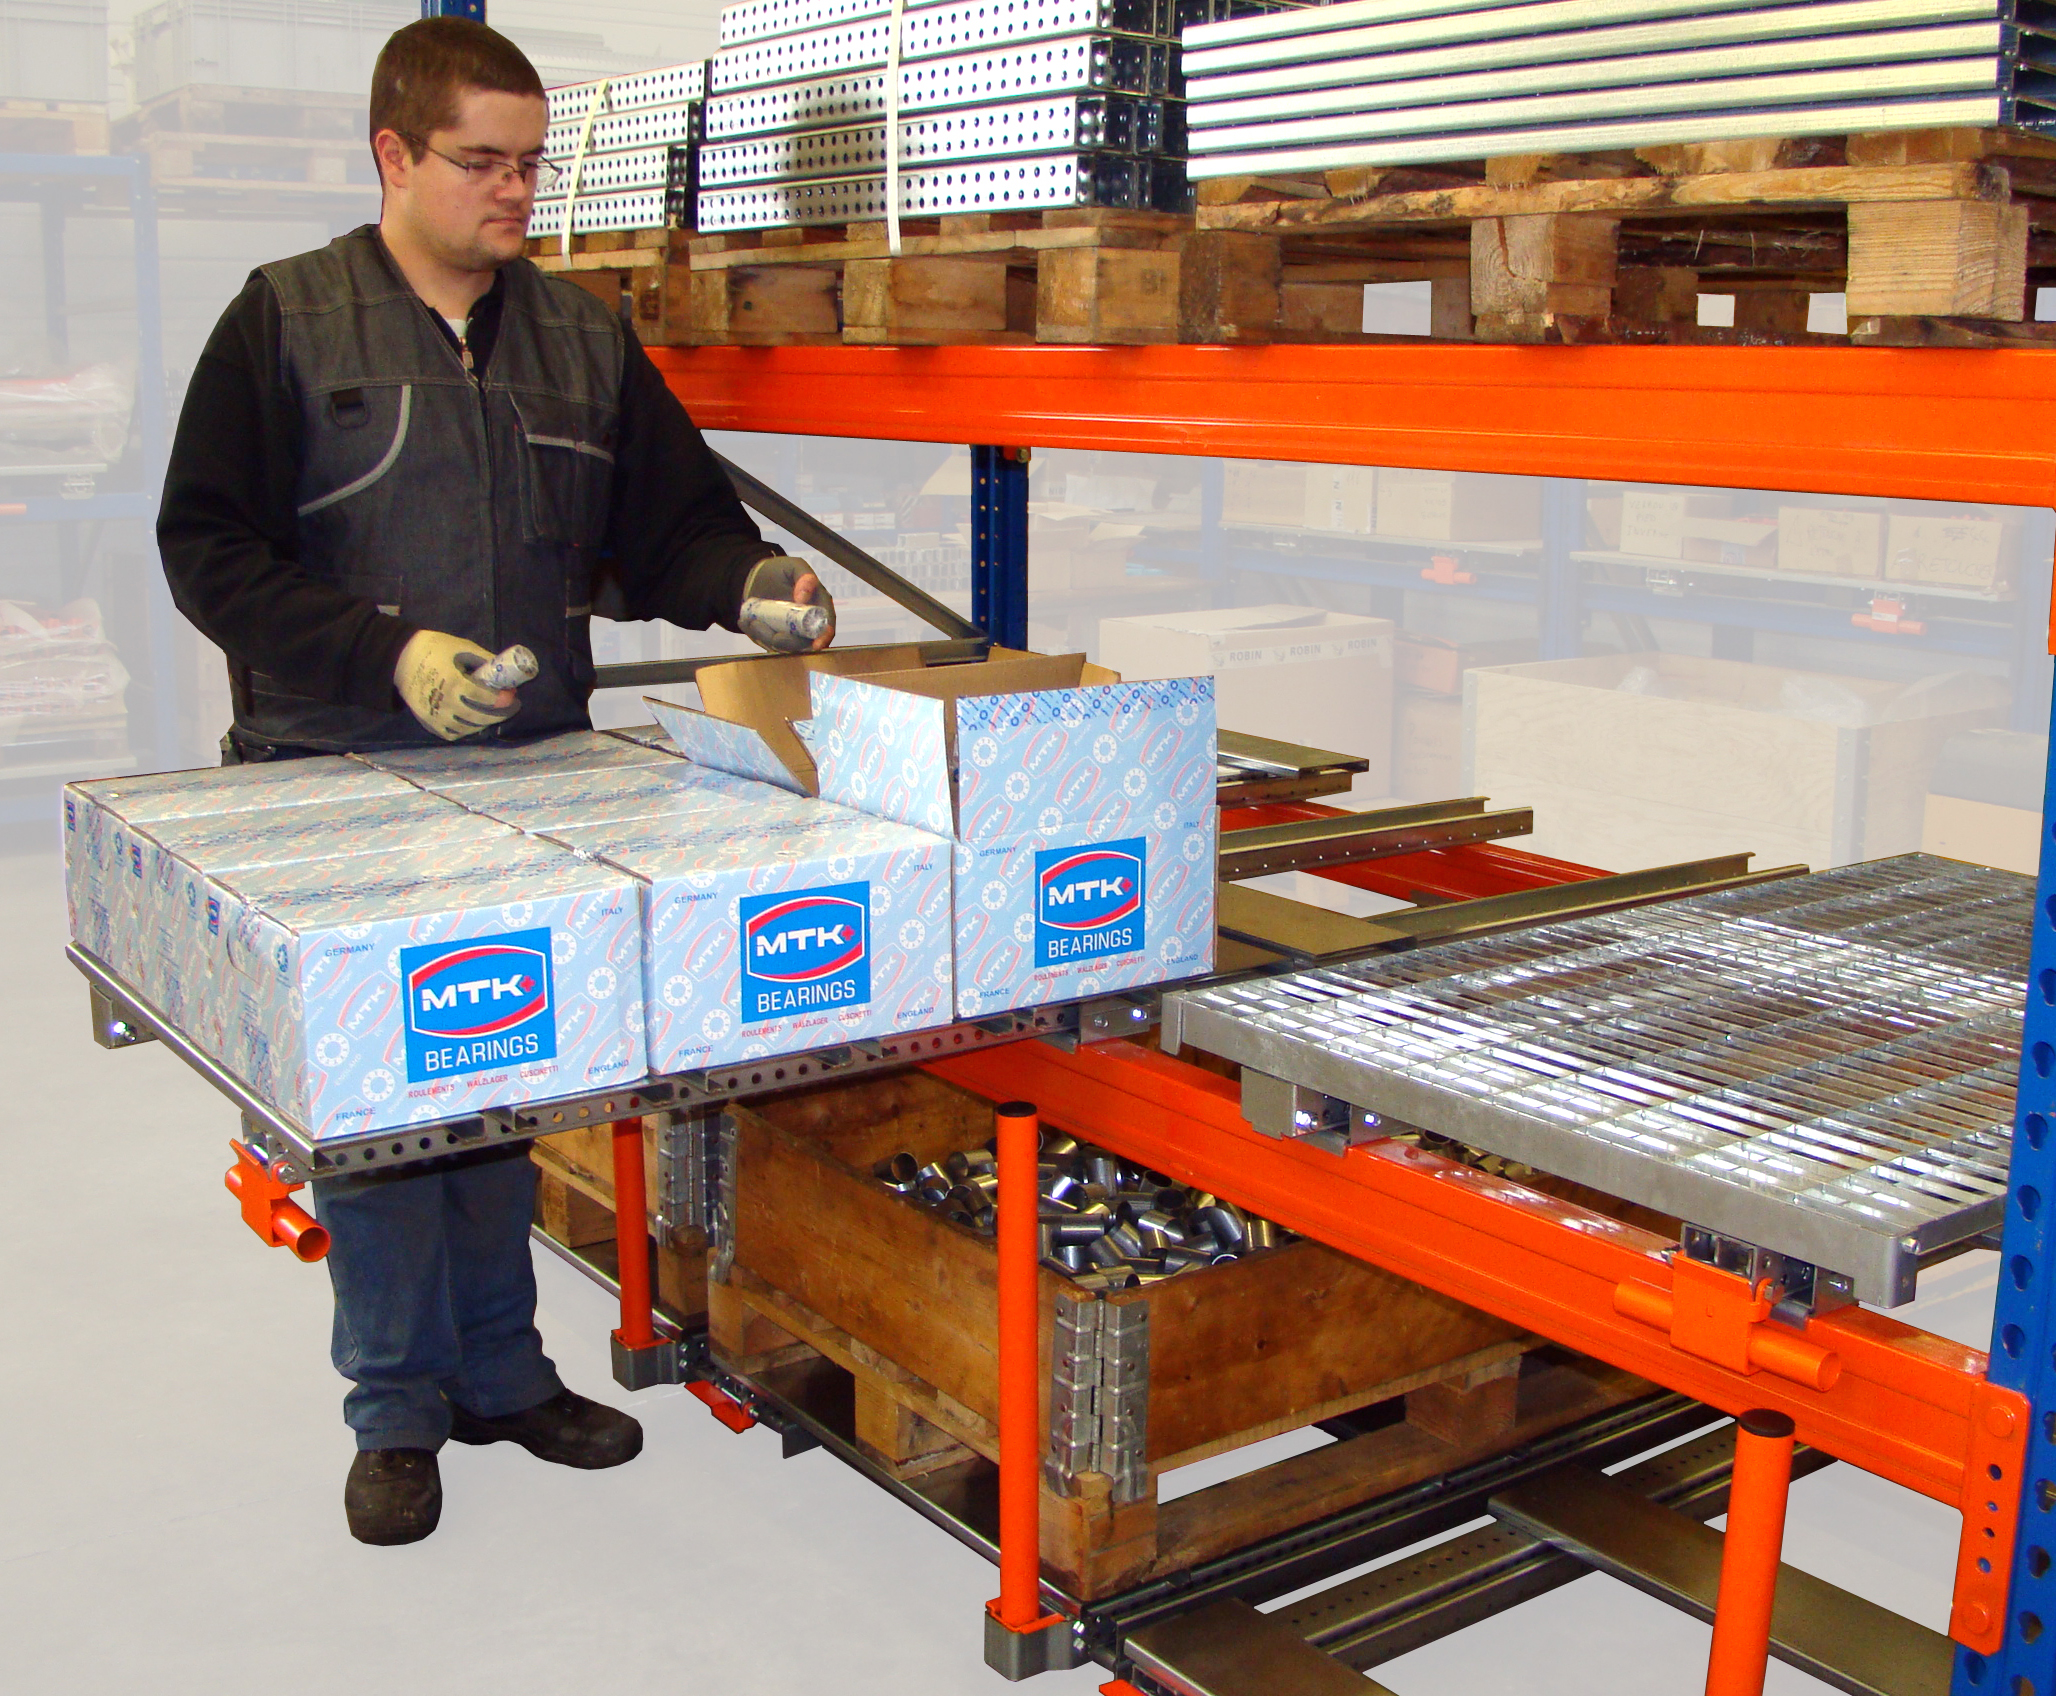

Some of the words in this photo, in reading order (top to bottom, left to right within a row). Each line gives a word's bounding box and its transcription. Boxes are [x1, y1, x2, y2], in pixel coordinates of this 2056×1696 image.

[1290, 644, 1321, 657] ROBIN
[1348, 638, 1377, 650] ROBIN
[1229, 650, 1262, 663] ROBIN
[979, 847, 1017, 857] GERMANY
[913, 863, 933, 872] ITALY
[674, 892, 718, 904] GERMANY
[601, 906, 624, 917] ITALY
[1048, 927, 1133, 959] BEARINGS
[325, 943, 375, 957] GERMANY
[692, 930, 726, 974] MTK
[1166, 954, 1199, 965] ENGLAND
[757, 979, 856, 1013] BEARINGS
[979, 988, 1010, 999] FRANCE
[348, 987, 383, 1031] MTK
[896, 1006, 934, 1020] ENGLAND
[425, 1033, 539, 1072] BEARINGS
[678, 1045, 713, 1058] FRANCE
[588, 1059, 629, 1075] ENGLAND
[408, 1083, 455, 1099] ROULEMENTS
[336, 1107, 376, 1121] FRANCE
